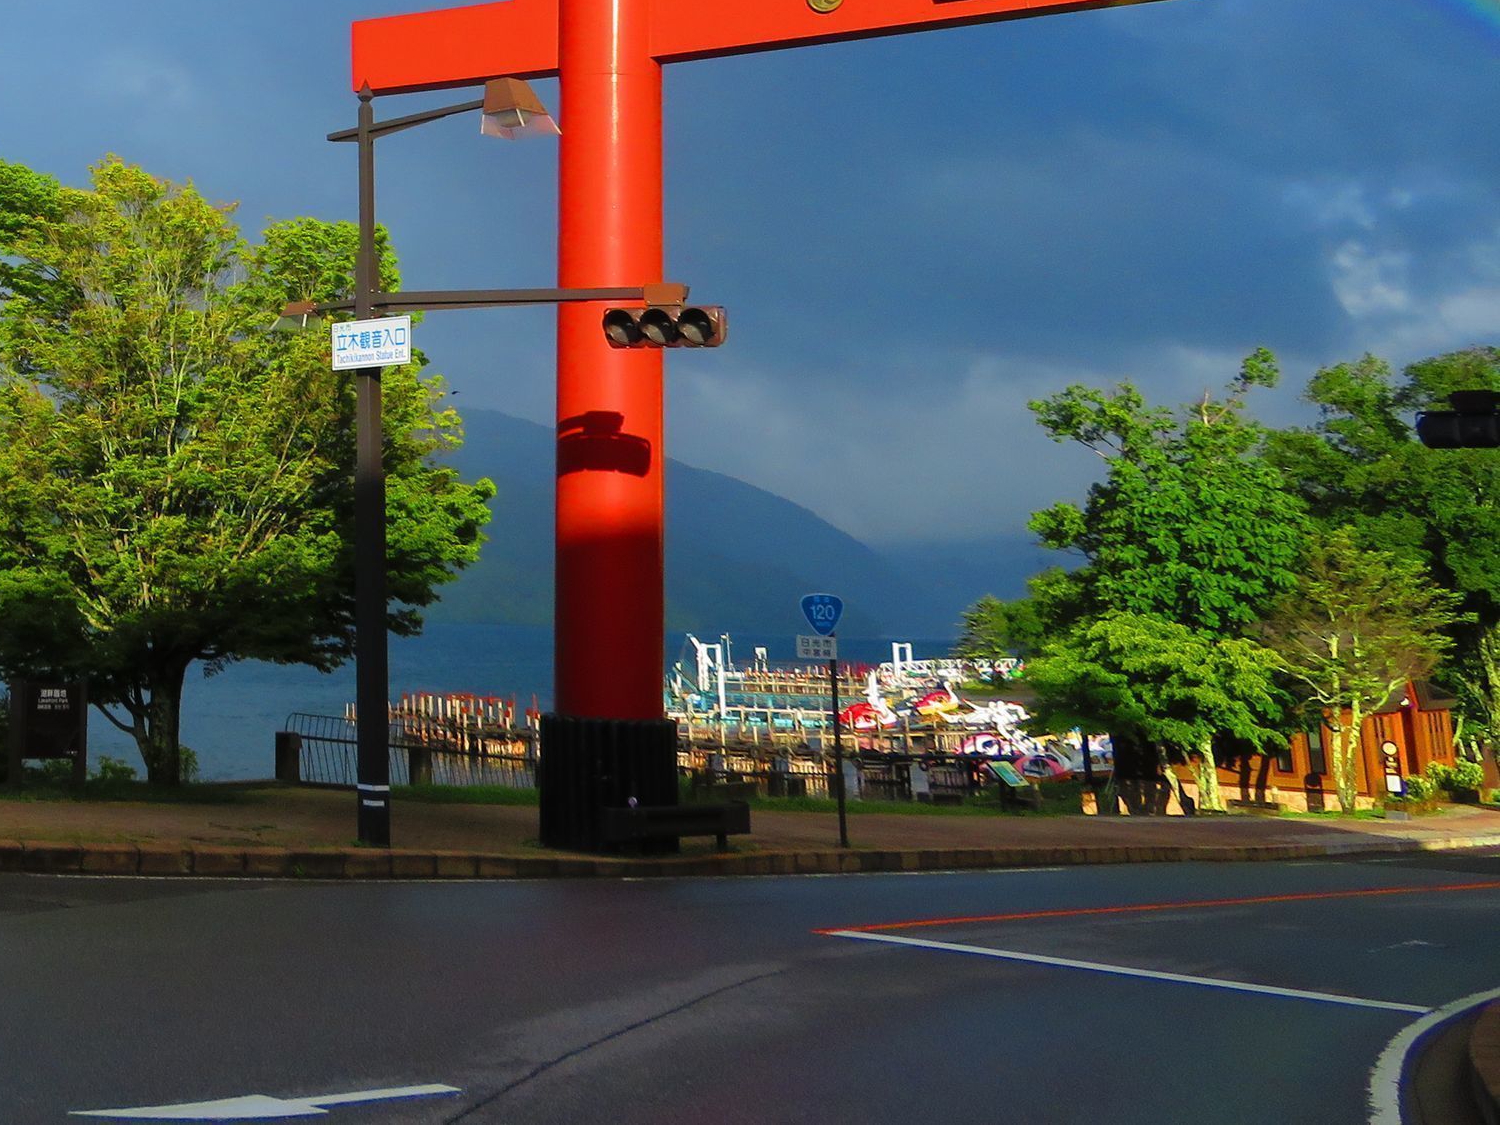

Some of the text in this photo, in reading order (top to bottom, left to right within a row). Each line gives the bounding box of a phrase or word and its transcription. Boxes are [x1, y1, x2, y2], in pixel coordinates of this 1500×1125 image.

[810, 604, 835, 621] 120
[802, 638, 832, 647] 日光市
